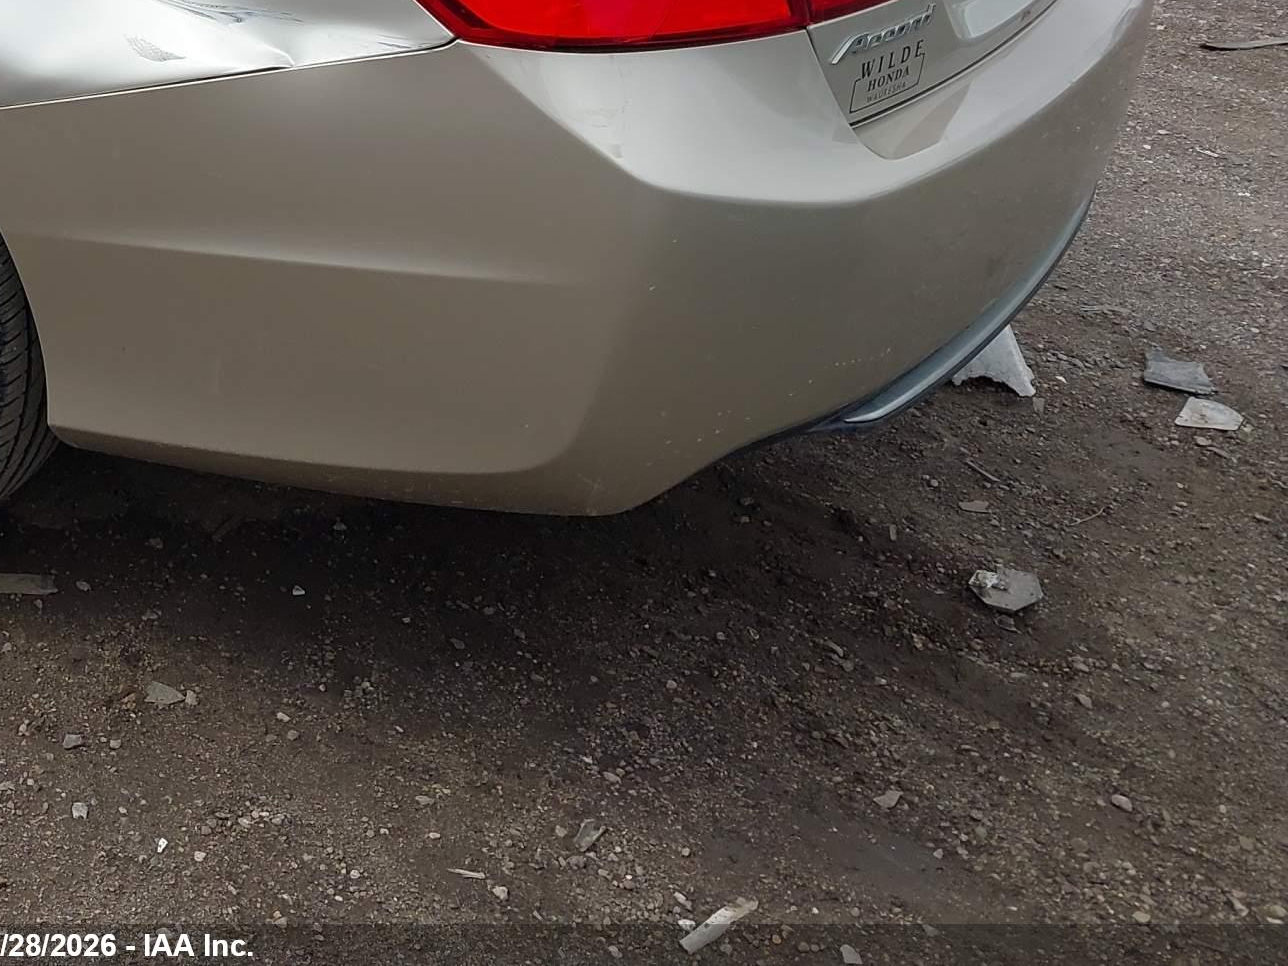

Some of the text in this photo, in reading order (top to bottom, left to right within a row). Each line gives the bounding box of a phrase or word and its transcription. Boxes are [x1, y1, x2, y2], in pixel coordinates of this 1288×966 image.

[829, 3, 937, 65] Accord
[862, 39, 924, 79] WILDE
[867, 66, 910, 92] HONDA
